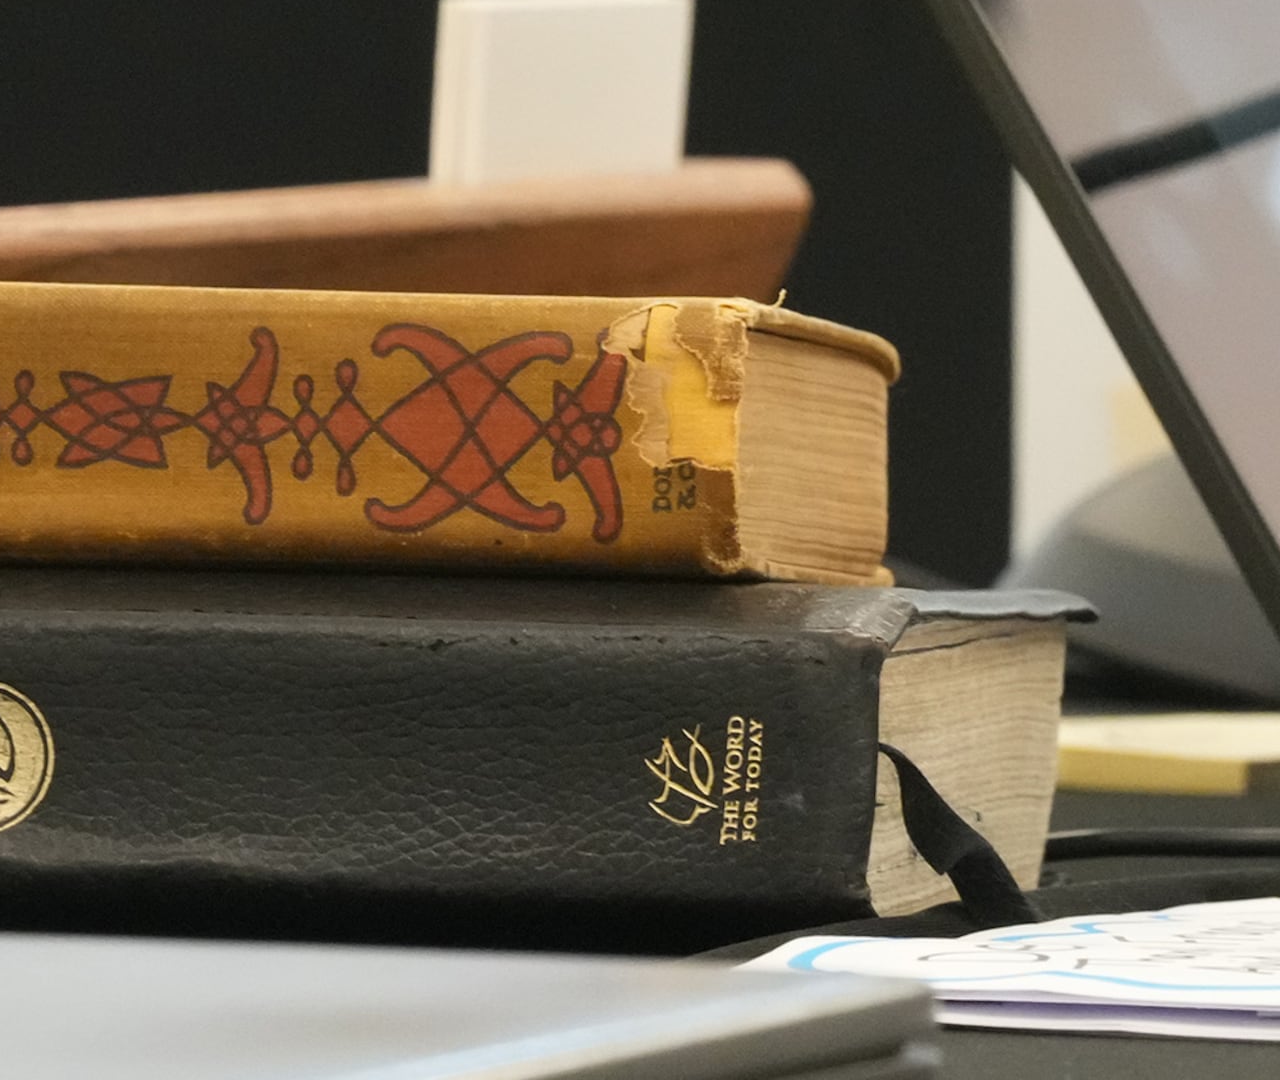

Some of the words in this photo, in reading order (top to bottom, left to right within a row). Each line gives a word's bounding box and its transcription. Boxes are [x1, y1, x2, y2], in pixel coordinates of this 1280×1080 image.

[722, 715, 746, 795] WORD
[745, 718, 764, 793] TODAY
[719, 799, 741, 846] THE
[742, 797, 760, 843] FOR
